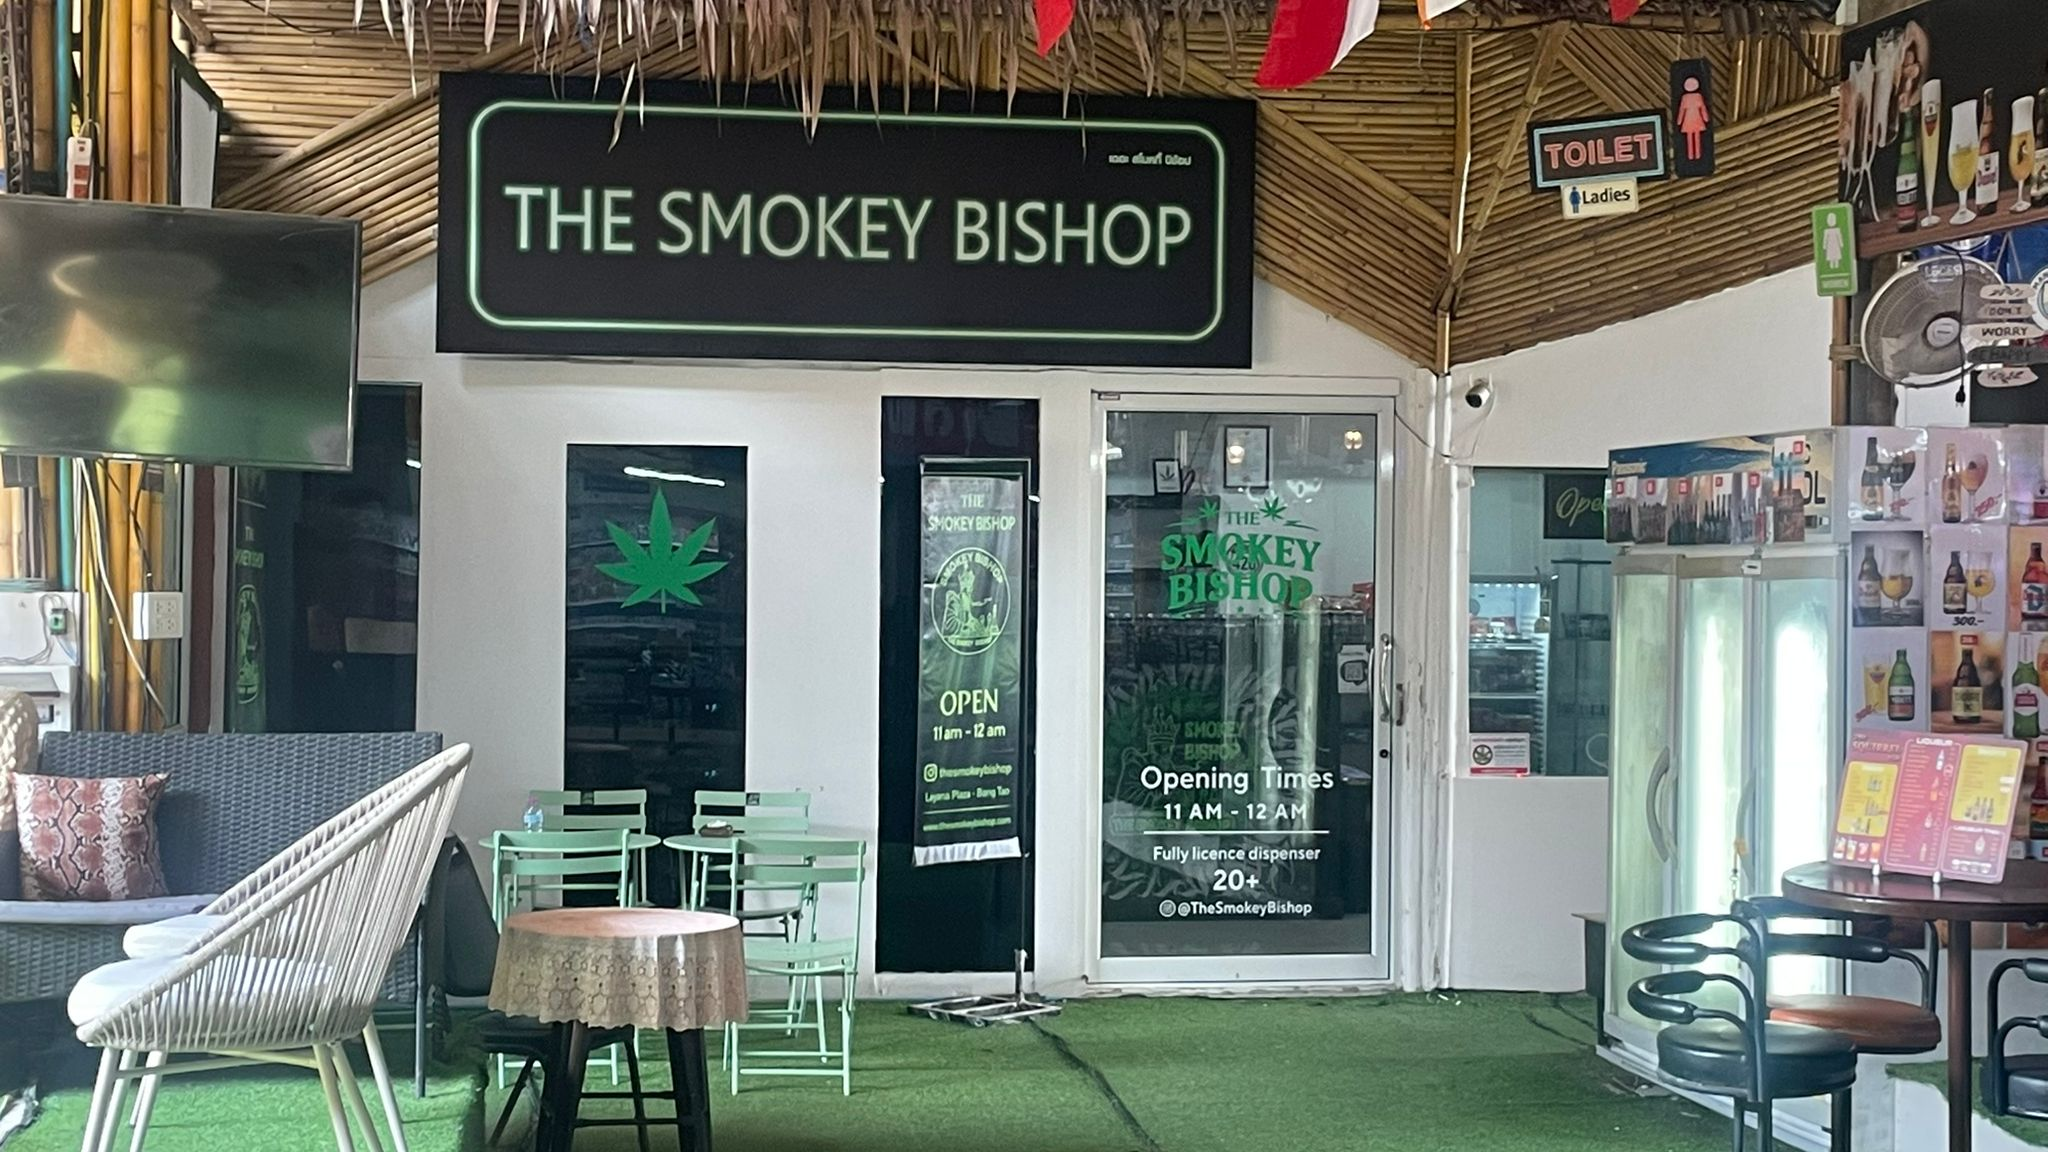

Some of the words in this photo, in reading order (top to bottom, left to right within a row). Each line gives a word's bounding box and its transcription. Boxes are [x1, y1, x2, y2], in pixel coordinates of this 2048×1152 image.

[1544, 134, 1653, 169] TOILET
[1582, 188, 1631, 205] Ladies
[504, 185, 635, 252] THE
[658, 190, 932, 261] SMOKEY
[956, 200, 1192, 266] BISHOP
[1981, 326, 2029, 337] WORRY
[960, 493, 985, 508] THE
[1556, 487, 1604, 527] Ope
[928, 515, 974, 532] SMOKEY
[976, 515, 1016, 531] BISHOP
[1226, 511, 1261, 526] THE
[1161, 532, 1321, 573] SMOKEY
[941, 552, 973, 586] SMOKEY
[975, 552, 1003, 584] BISHOP
[1168, 570, 1313, 610] BISHOP
[940, 688, 999, 717] OPEN
[973, 722, 985, 738] 12
[986, 725, 1006, 737] am
[1140, 765, 1249, 795] Opening
[1260, 766, 1334, 789] Times
[1163, 803, 1182, 820] 11
[1189, 803, 1222, 820] AM
[1246, 803, 1267, 820] 12
[1275, 803, 1308, 820] AM
[1153, 846, 1193, 864] Fully
[1192, 846, 1245, 861] licence
[1248, 846, 1321, 864] dispenser
[1213, 869, 1259, 891] 20+
[1177, 900, 1312, 917] @TheSmokeyBishop
